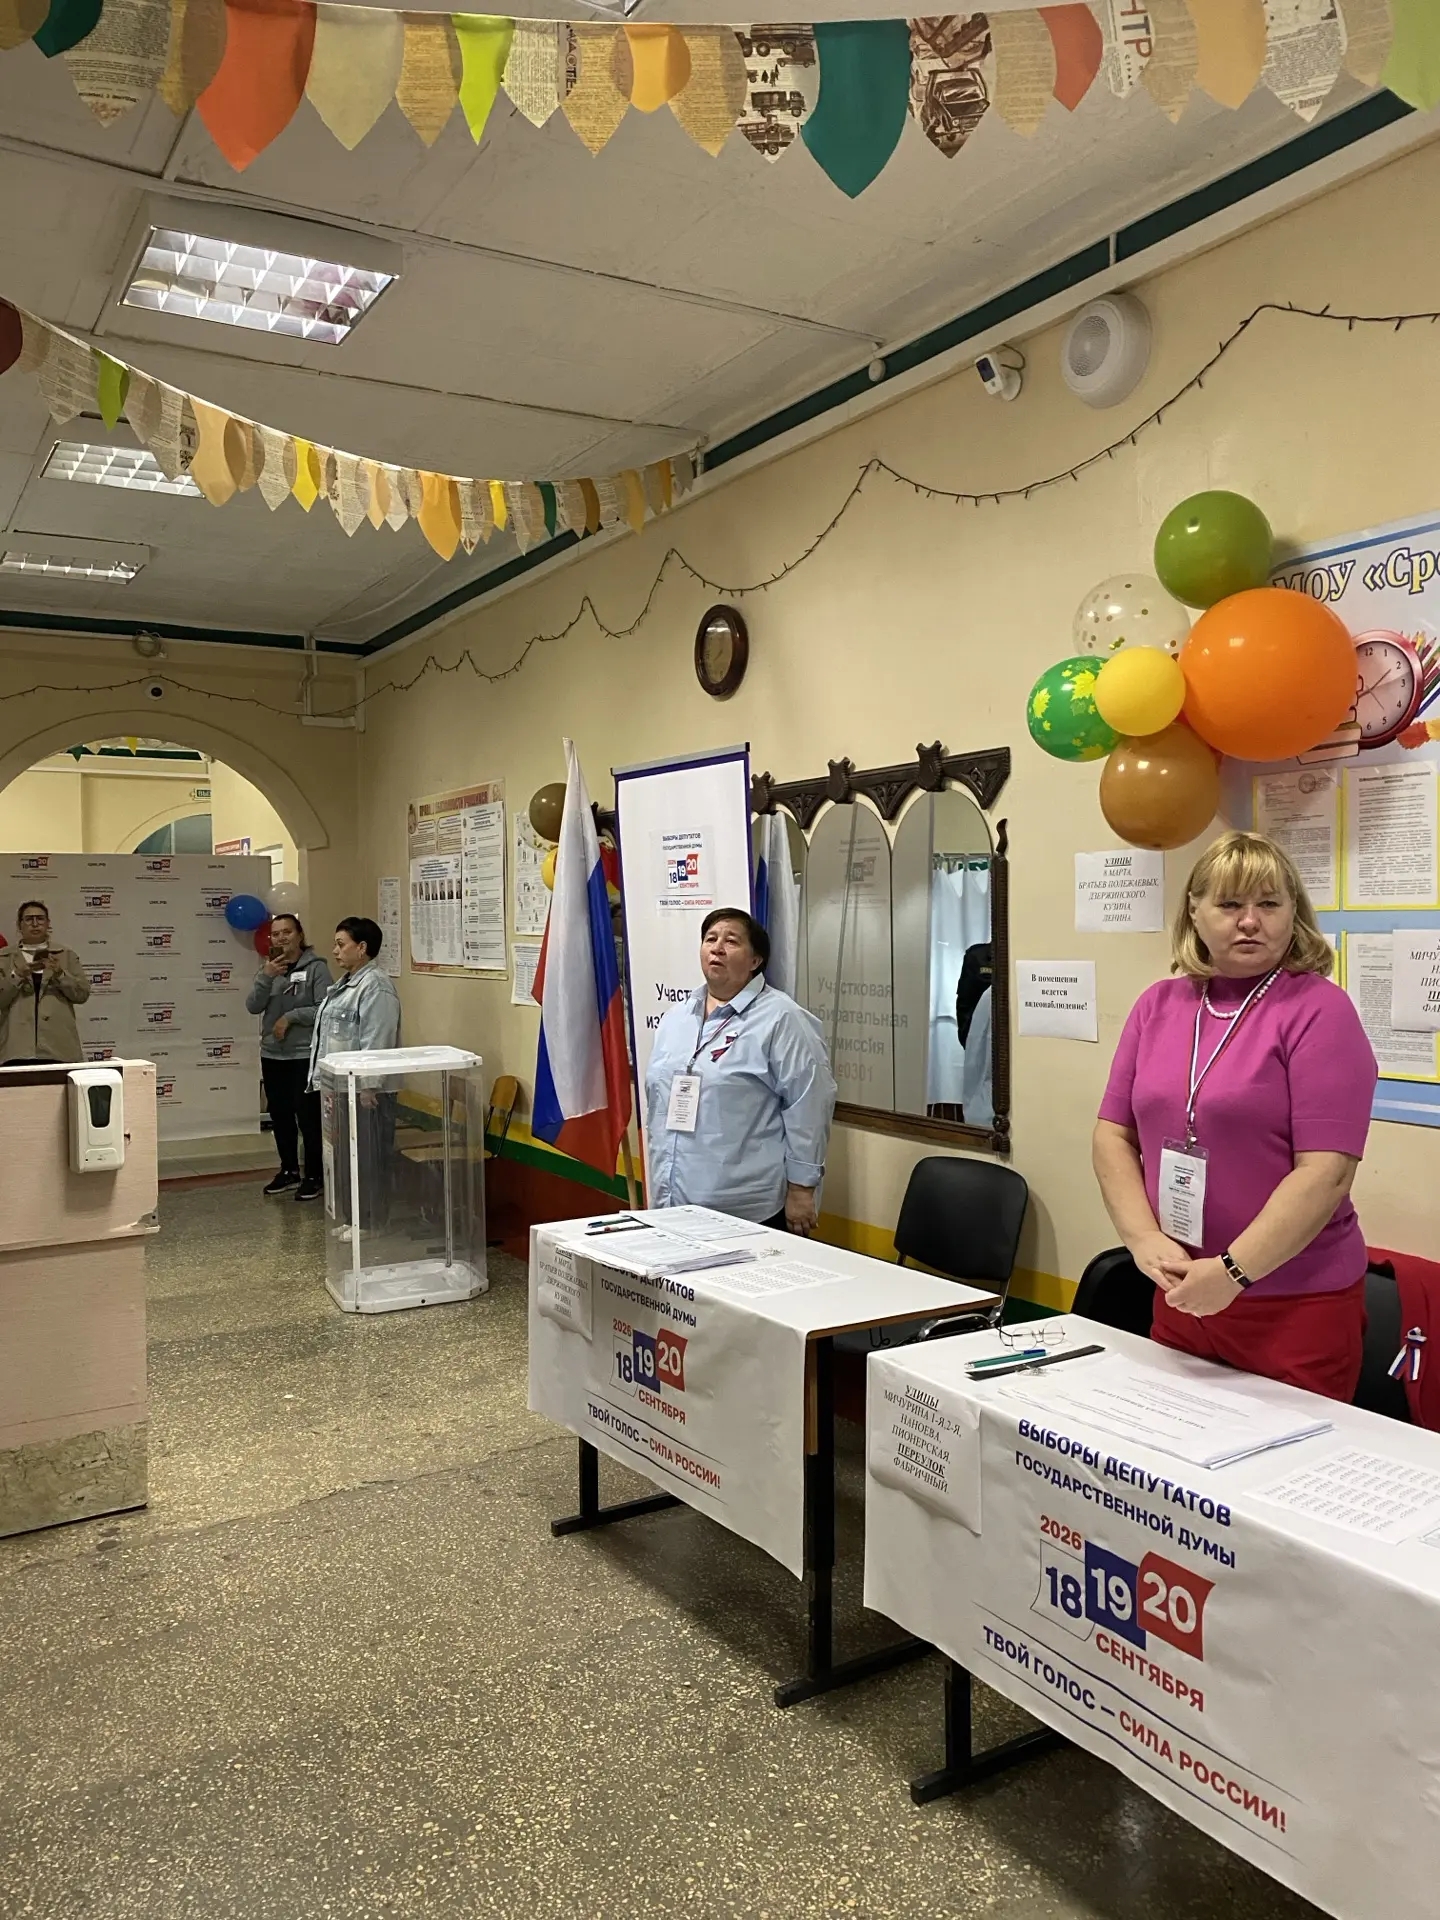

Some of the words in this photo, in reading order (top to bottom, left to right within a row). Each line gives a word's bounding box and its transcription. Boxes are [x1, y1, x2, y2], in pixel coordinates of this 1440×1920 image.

[1363, 547, 1440, 595] «Ср
[1364, 647, 1374, 657] 12
[1383, 648, 1388, 657] 1
[1396, 661, 1402, 670] 2
[1401, 678, 1406, 688] 3
[1396, 700, 1402, 709] 4
[1366, 721, 1372, 731] 6
[1382, 716, 1387, 725] 5
[669, 872, 678, 883] 18
[677, 865, 686, 876] 19
[686, 859, 697, 870] 20
[1078, 881, 1107, 889] БРАТЬЕВ
[817, 976, 892, 998] Учстковая
[1031, 973, 1036, 982] В
[1038, 975, 1078, 983] помещении
[655, 983, 692, 1002] Участ
[1025, 1000, 1088, 1011] видеонаблюдение!
[646, 1012, 665, 1029] из
[824, 1036, 885, 1056] миссия
[601, 1278, 671, 1316] ГОСУДАРСТВЕННОЙ
[672, 1308, 697, 1328] ДУМЫ
[613, 1318, 632, 1337] 2026
[615, 1351, 632, 1384] 18
[635, 1345, 654, 1378] 19
[658, 1340, 682, 1377] 20
[638, 1389, 686, 1425] СЕНТЯБРЯ
[884, 1389, 929, 1421] МИЧУРИНА
[905, 1384, 940, 1411] УЛИЦЫ
[587, 1402, 610, 1426] ТВОЙ
[611, 1416, 639, 1443] ГОЛОС
[649, 1437, 673, 1464] СИЛА
[675, 1455, 721, 1489] РОССИИ!
[891, 1424, 951, 1464] ПИОНЕРСКАЯ,
[897, 1442, 946, 1476] ПЕРЕУЛОК
[1018, 1418, 1100, 1469] ВЫБОРЫ
[1103, 1456, 1232, 1527] ДЕПУТАТОВ
[1015, 1451, 1174, 1539] ГОСУДАРСТВЕННОЙ
[1178, 1527, 1236, 1569] ДУМЫ
[1040, 1514, 1082, 1551] 2026
[1045, 1566, 1082, 1619] 18
[1091, 1567, 1133, 1621] 19
[1143, 1571, 1197, 1634] 20
[1096, 1633, 1204, 1713] СЕНТЯБРЯ
[983, 1625, 1030, 1670] ТВОЙ
[1034, 1656, 1095, 1710] ГОЛОС
[1119, 1710, 1174, 1764] СИЛА
[1179, 1757, 1287, 1833] РОССИИ!
